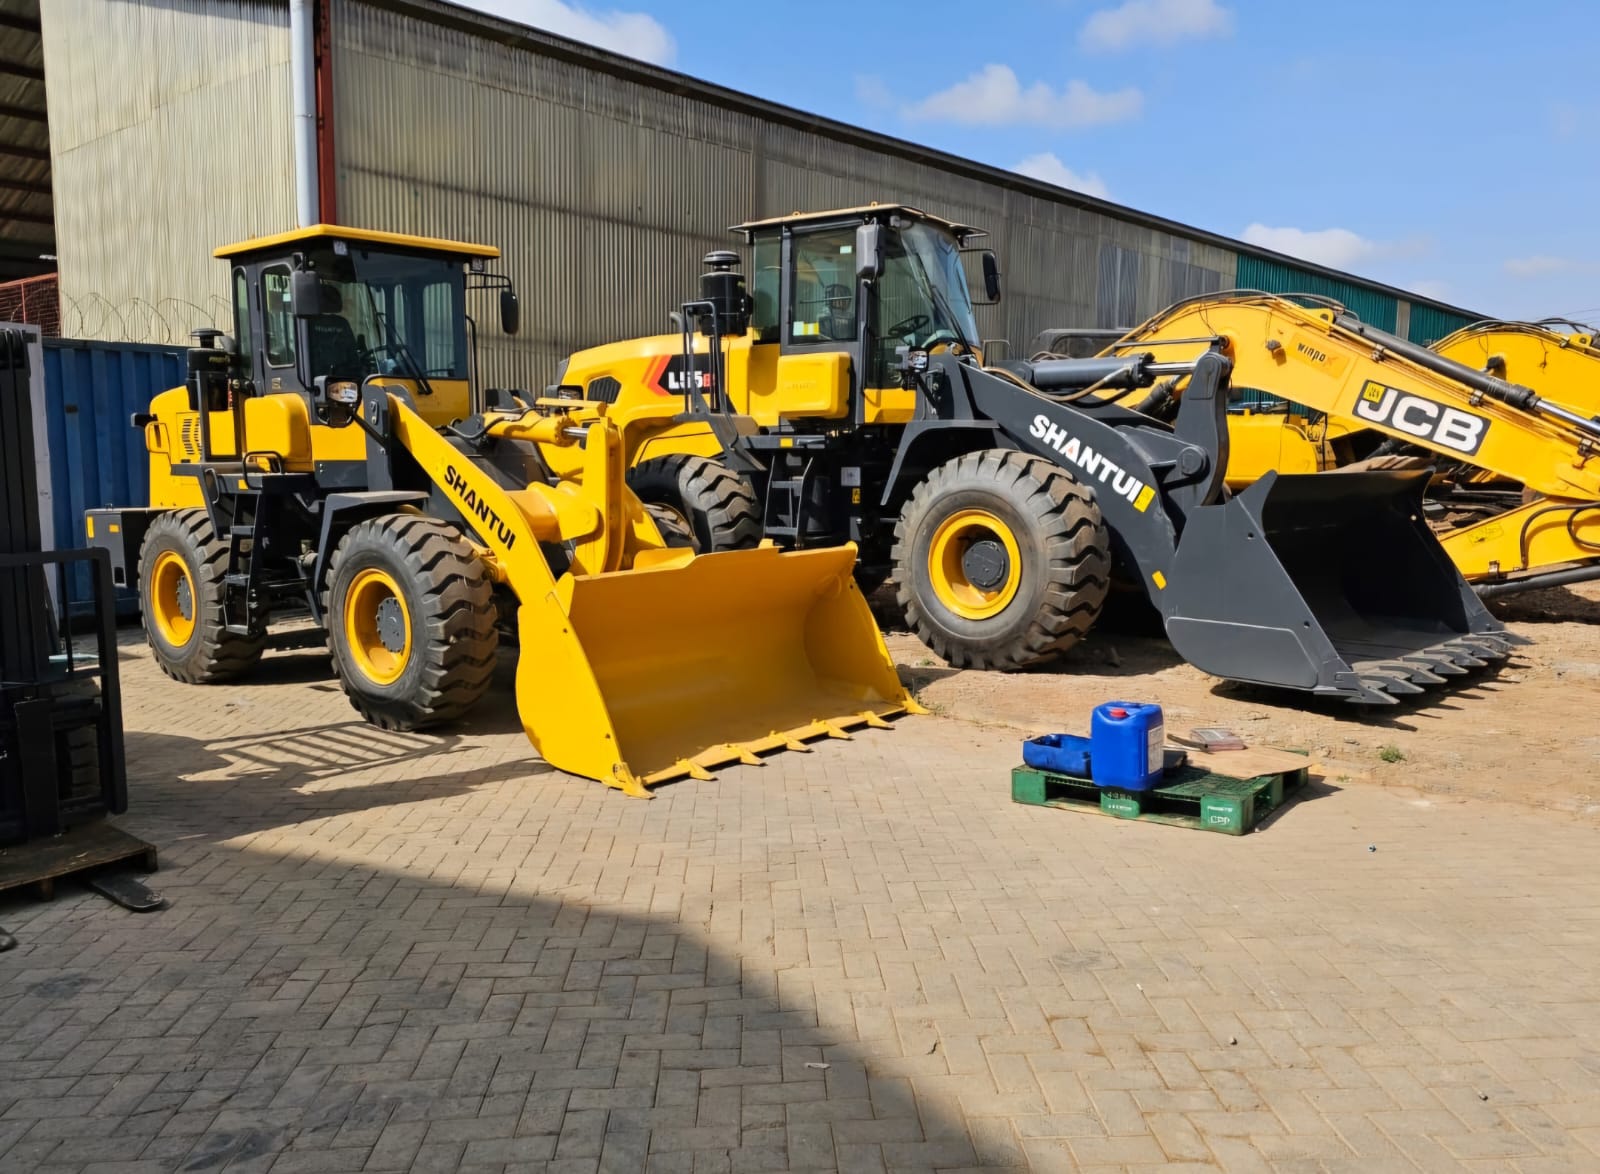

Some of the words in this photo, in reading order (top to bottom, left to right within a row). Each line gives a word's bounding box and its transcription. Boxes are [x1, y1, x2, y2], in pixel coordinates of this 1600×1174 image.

[1029, 414, 1144, 503] SHANTUI
[1357, 388, 1484, 452] JCB
[444, 465, 516, 551] SHANTUI
